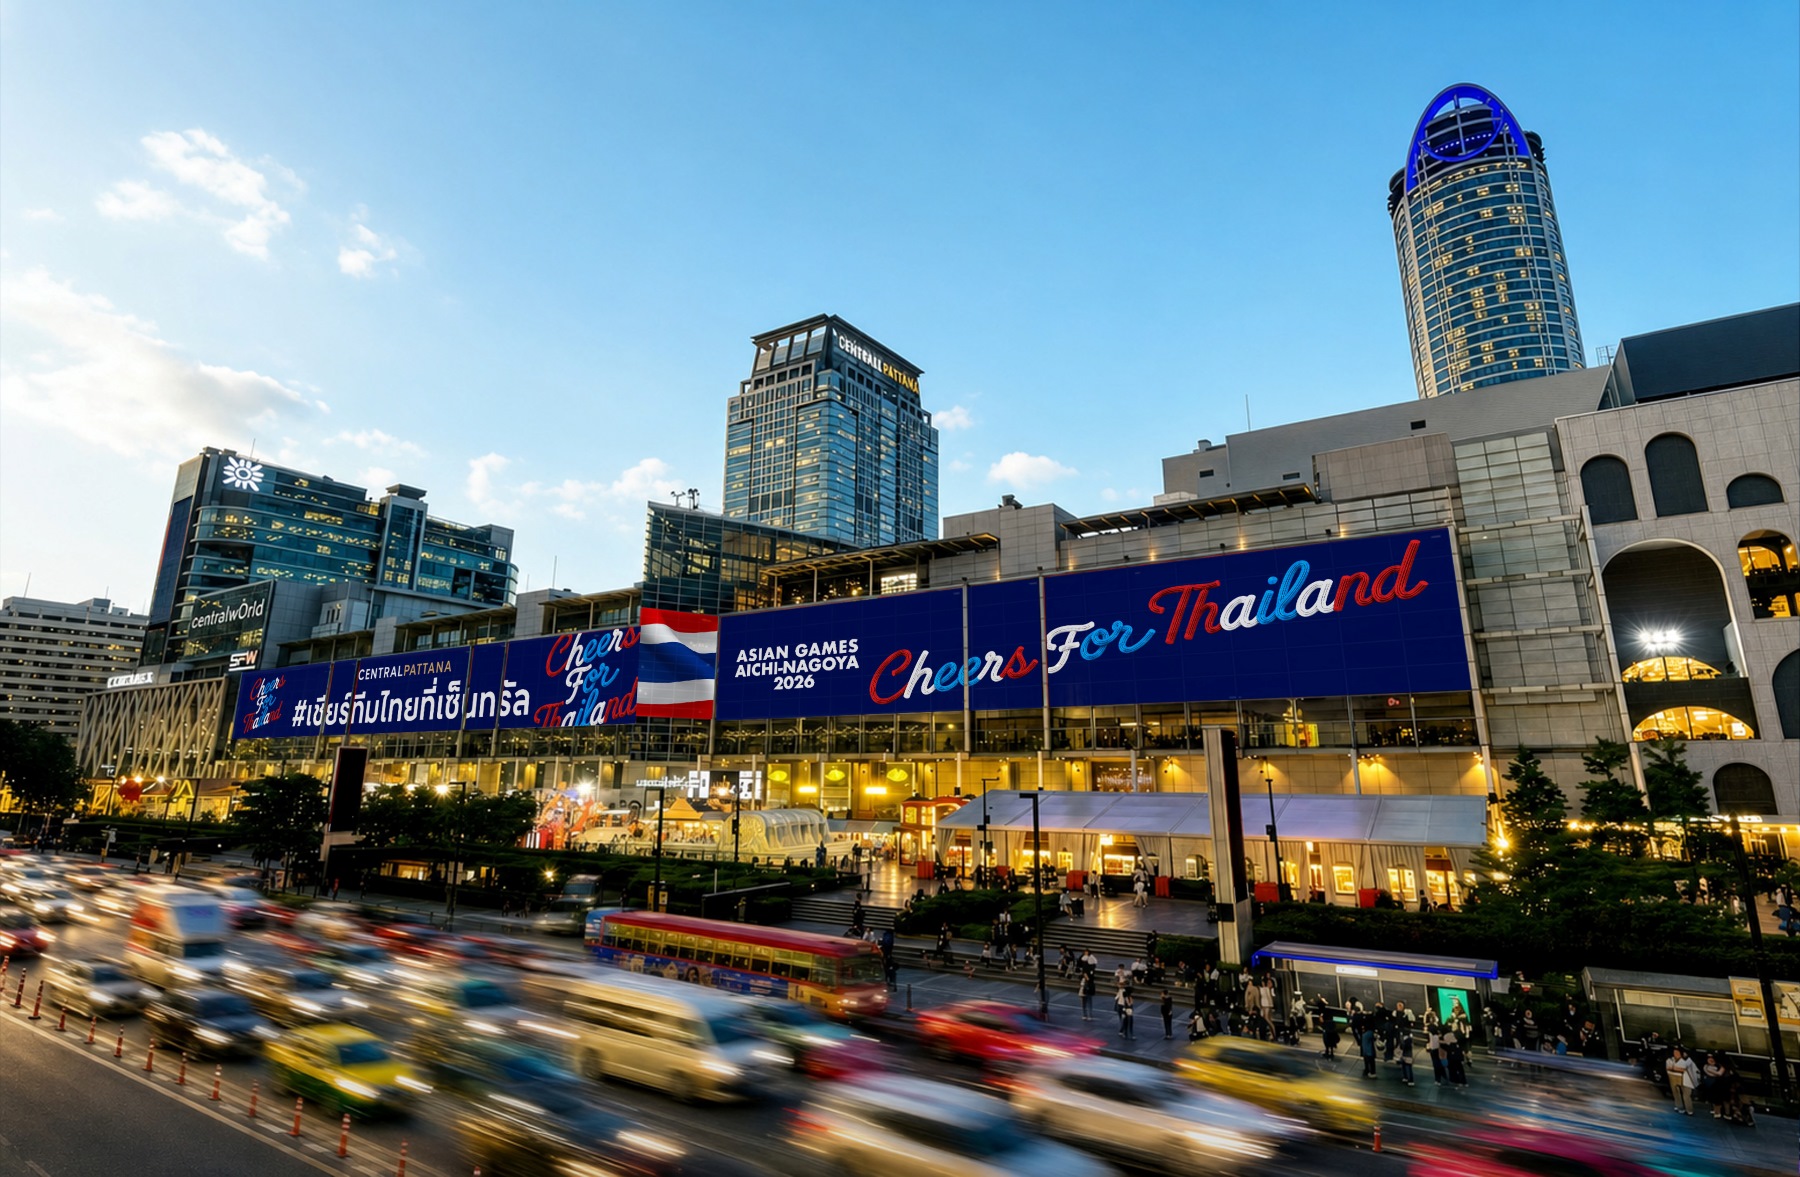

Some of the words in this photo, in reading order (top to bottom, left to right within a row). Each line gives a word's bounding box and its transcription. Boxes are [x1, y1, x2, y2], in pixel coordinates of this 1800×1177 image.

[869, 649, 1038, 704] Cheers
[1047, 621, 1156, 674] For
[1149, 539, 1429, 645] Thailand
[545, 628, 641, 677] Cheers
[736, 645, 789, 662] ASIAN
[795, 639, 859, 657] GAMES
[735, 655, 860, 678] AICHI-NAGOYA
[250, 674, 286, 701] Cheers
[565, 663, 620, 705] For
[773, 674, 816, 691] 2026
[243, 700, 283, 734] Thailand
[256, 694, 277, 715] For
[533, 676, 638, 728] Thailand
